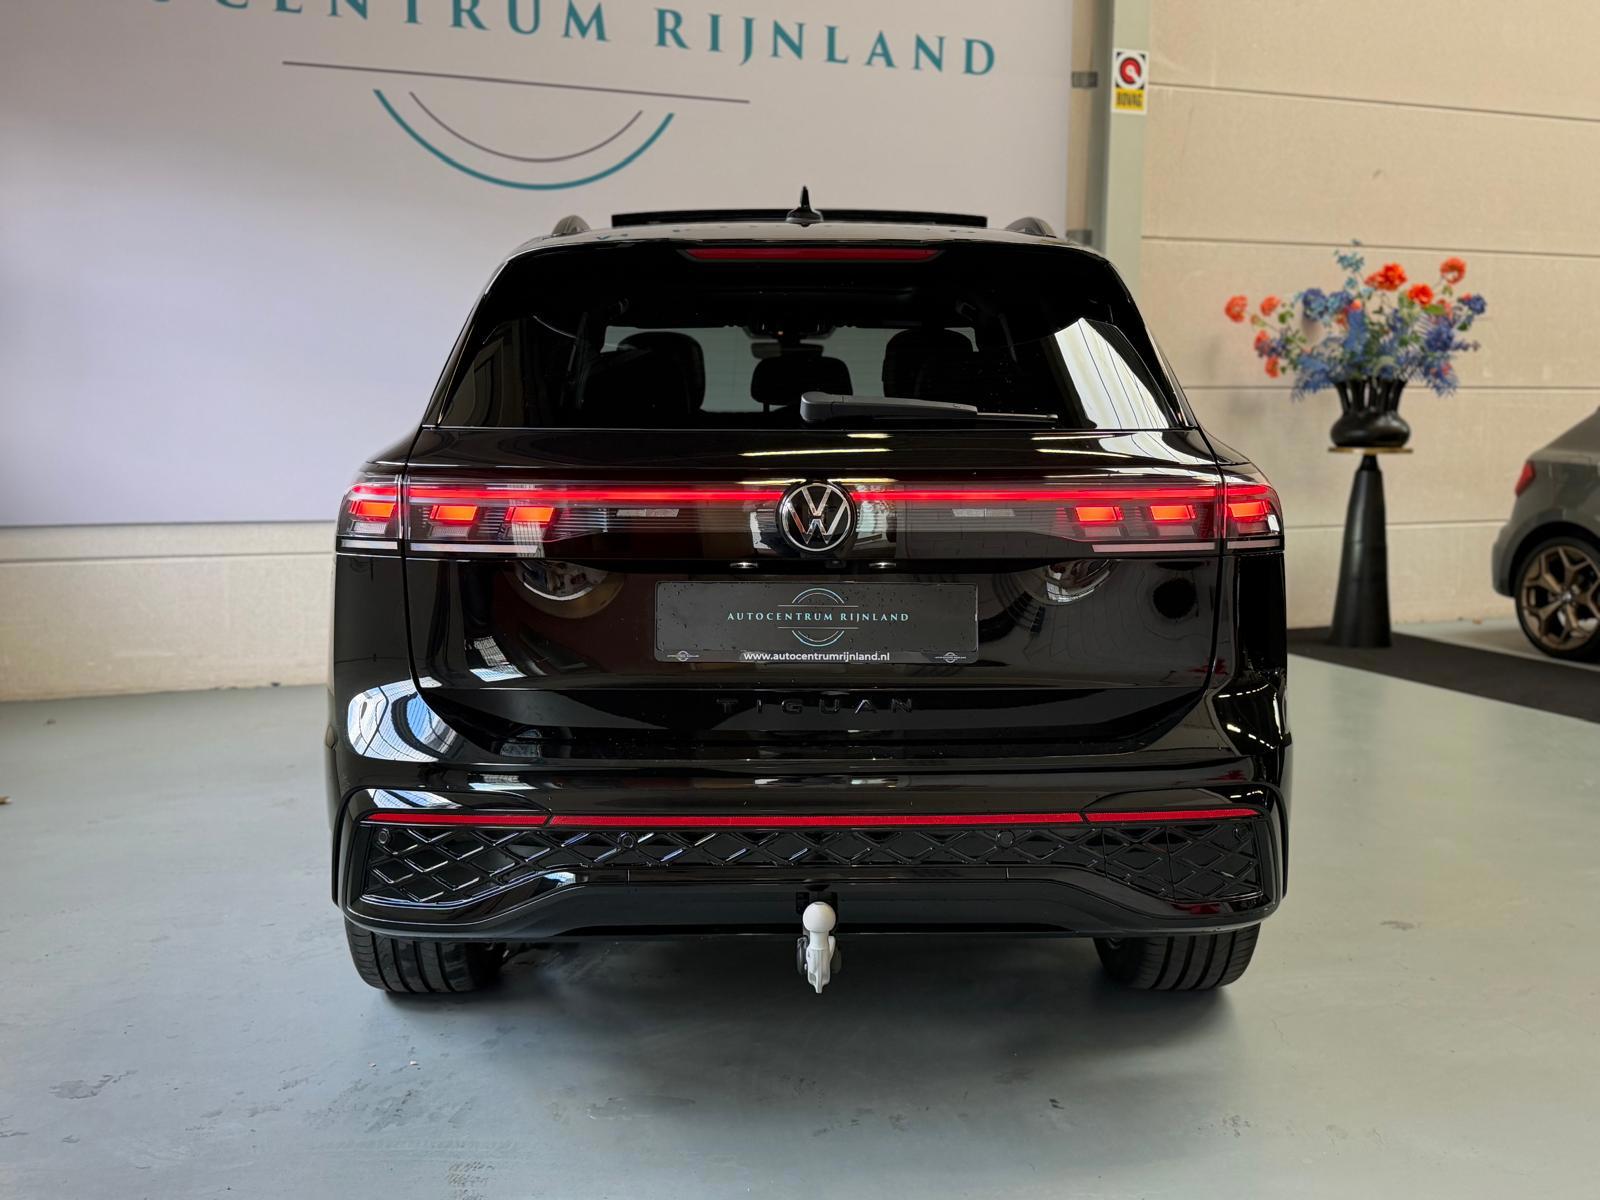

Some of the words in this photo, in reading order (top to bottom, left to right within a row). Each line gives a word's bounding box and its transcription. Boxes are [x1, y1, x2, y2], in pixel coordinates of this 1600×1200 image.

[654, 7, 997, 77] RIJNLAND
[727, 611, 833, 621] AUTOCENTRUM
[840, 612, 909, 623] RIJNLAND
[743, 650, 890, 663] www.autocentrumrijnland.nl
[716, 698, 913, 715] TIGUAN
